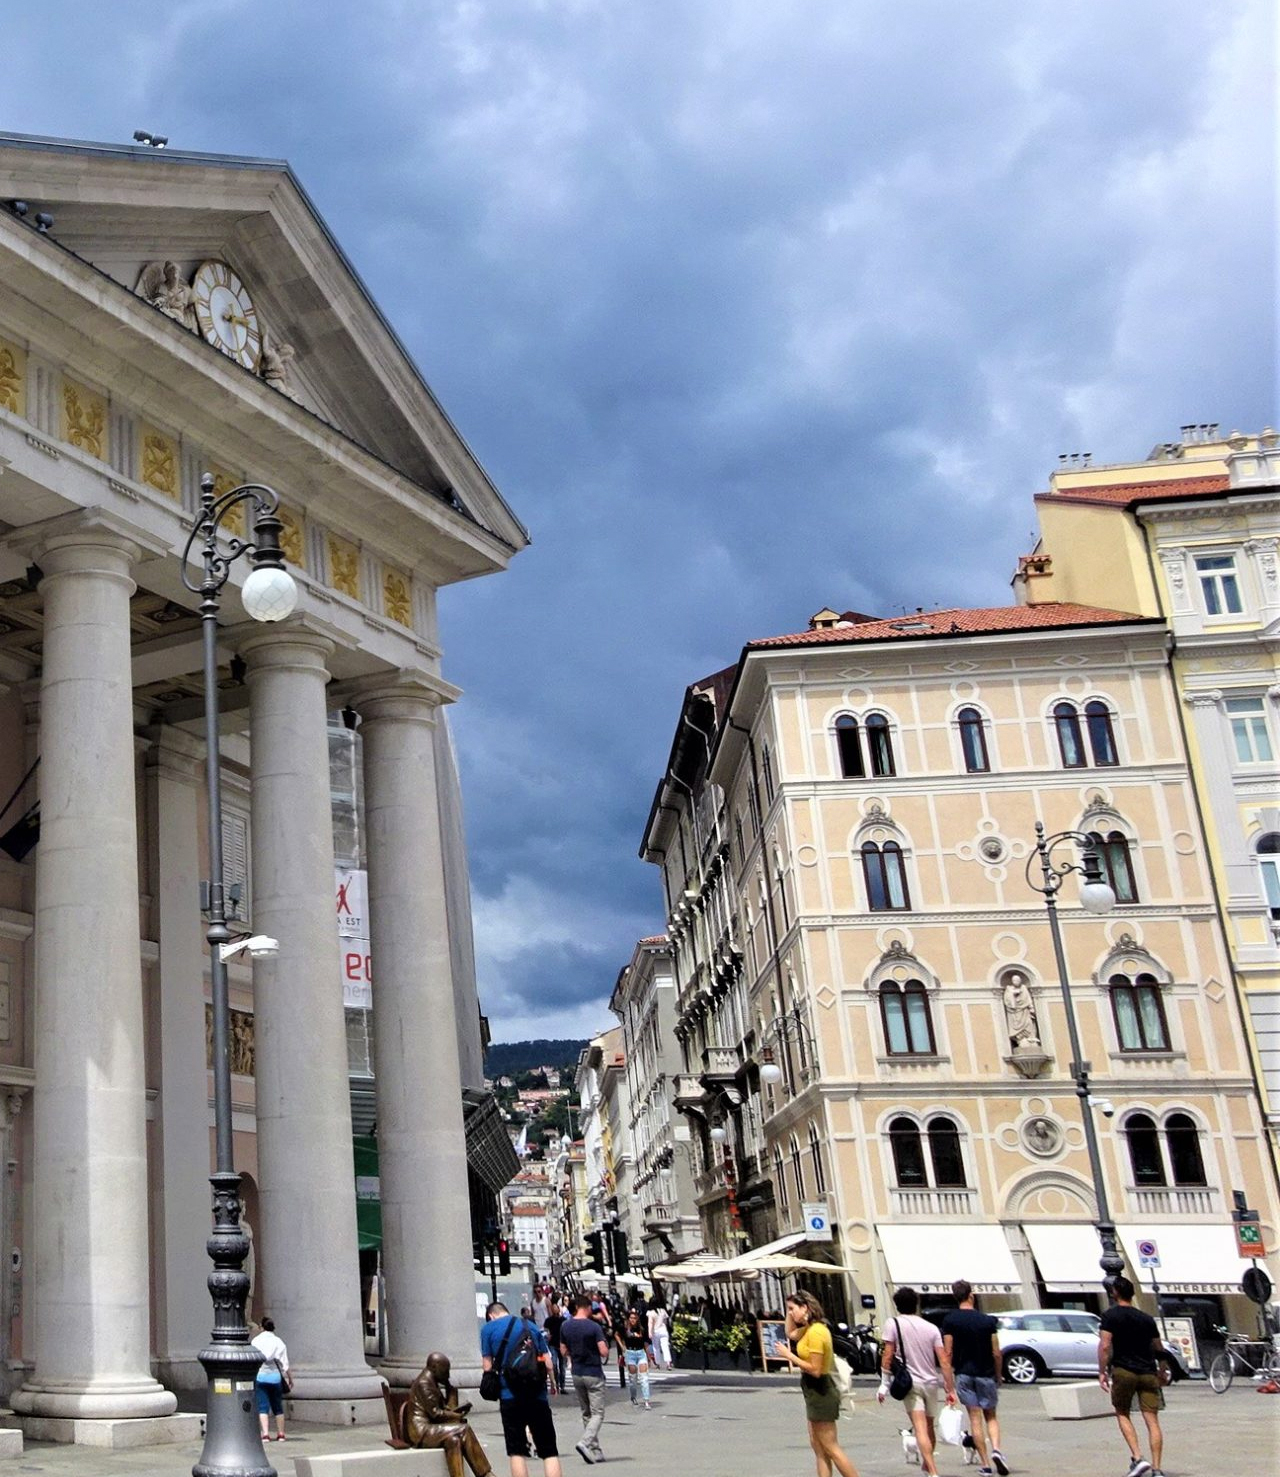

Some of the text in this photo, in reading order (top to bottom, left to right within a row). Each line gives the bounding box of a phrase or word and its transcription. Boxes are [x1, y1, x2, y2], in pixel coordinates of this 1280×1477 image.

[346, 917, 361, 926] EST
[934, 1284, 999, 1293] THSIA
[1165, 1284, 1232, 1293] THERESIA
